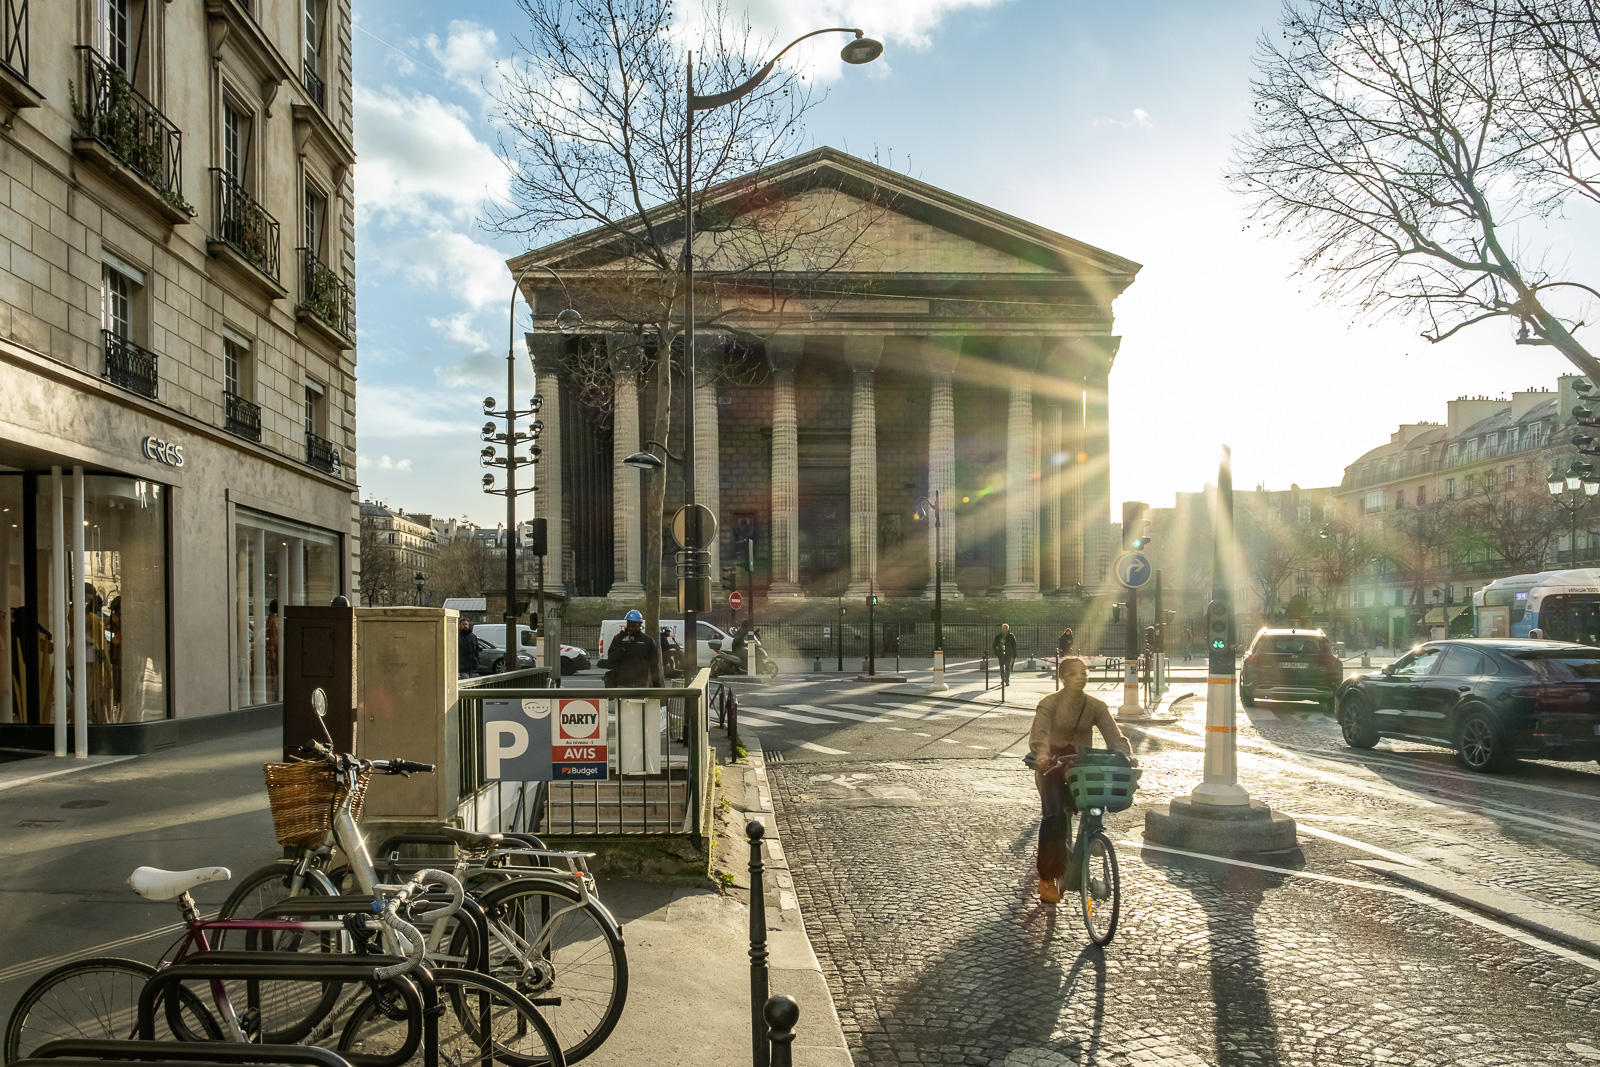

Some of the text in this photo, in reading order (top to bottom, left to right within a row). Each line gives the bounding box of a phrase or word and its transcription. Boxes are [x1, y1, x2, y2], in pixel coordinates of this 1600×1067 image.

[143, 436, 184, 467] ERES
[561, 713, 597, 724] DARTY
[486, 720, 529, 779] P
[563, 748, 596, 759] AVIS
[571, 767, 598, 776] Budget
